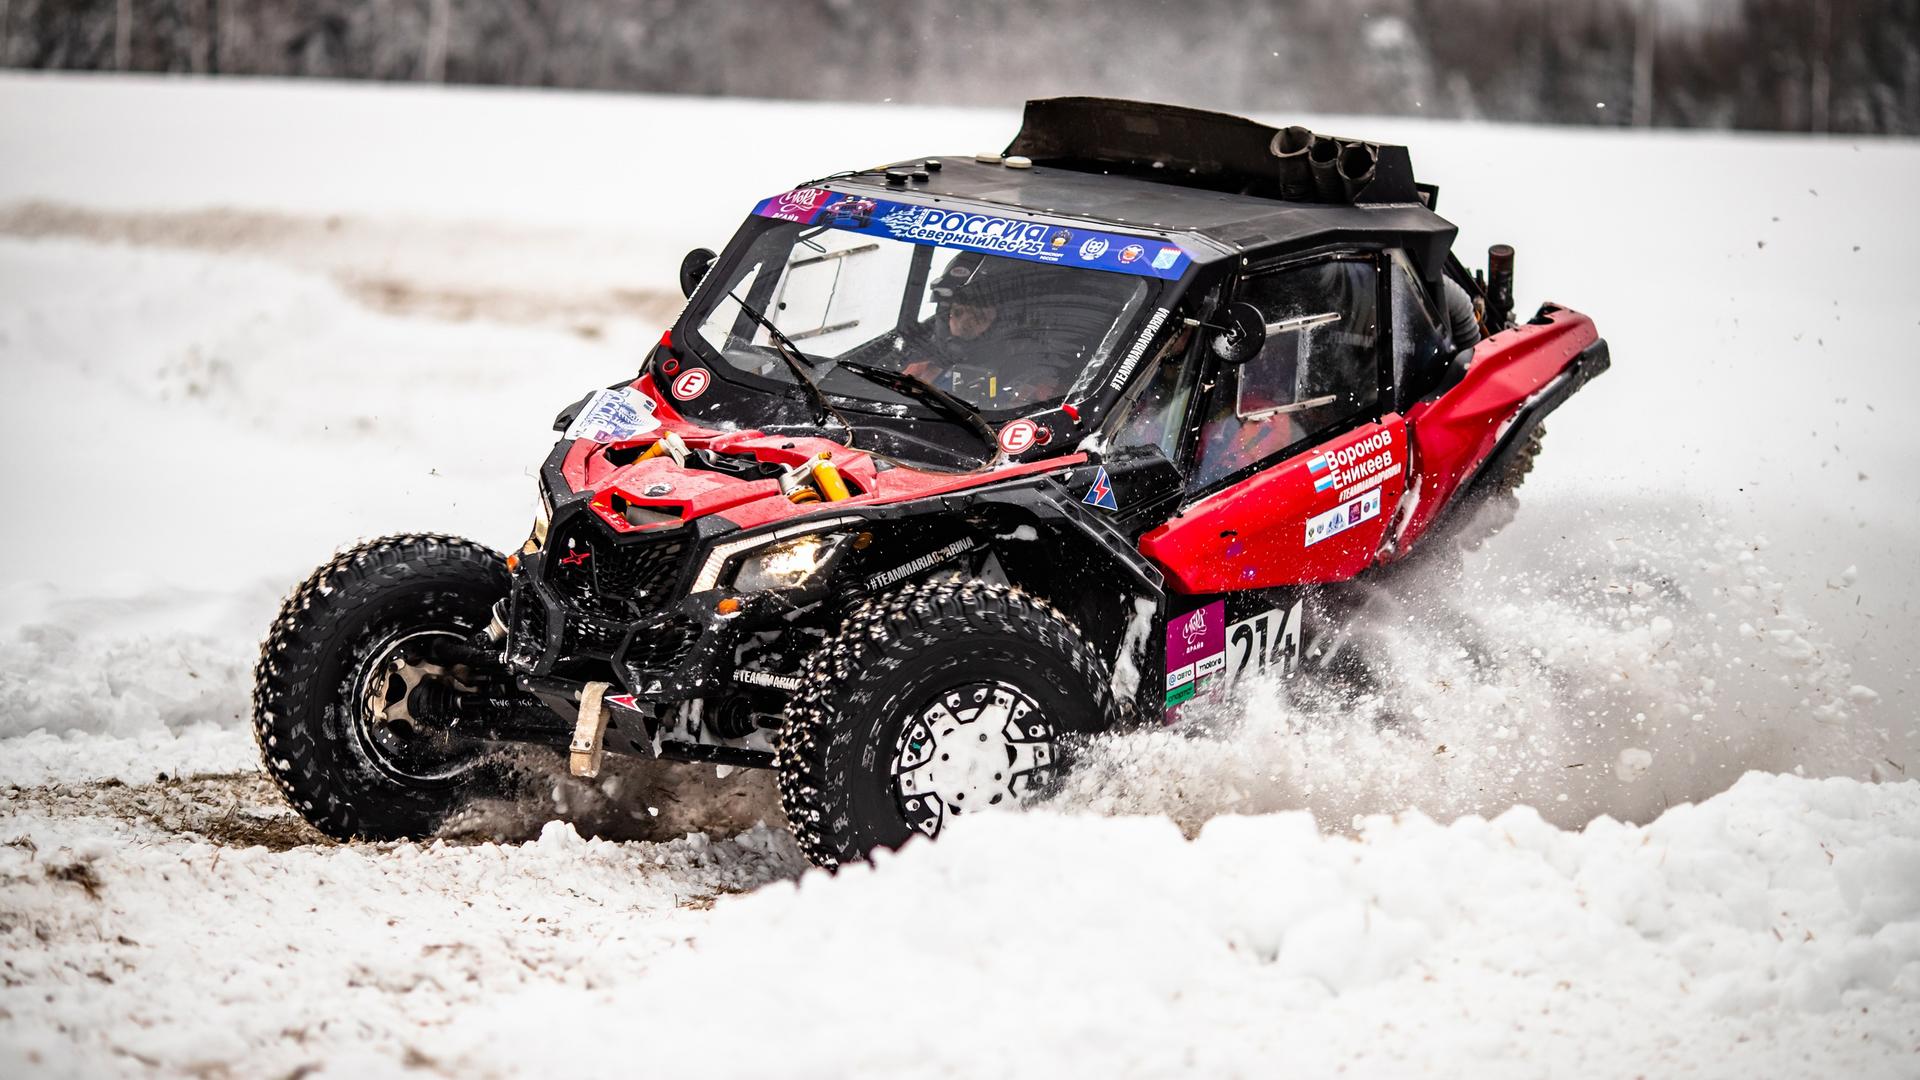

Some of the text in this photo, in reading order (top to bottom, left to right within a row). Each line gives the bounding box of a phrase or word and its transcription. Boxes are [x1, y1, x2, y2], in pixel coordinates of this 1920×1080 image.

[921, 208, 1047, 242] РОССИЯ
[681, 375, 700, 393] E
[1008, 428, 1027, 445] E
[1324, 430, 1392, 471] Воронов
[1331, 450, 1392, 490] Еникеев
[1231, 608, 1296, 690] 214
